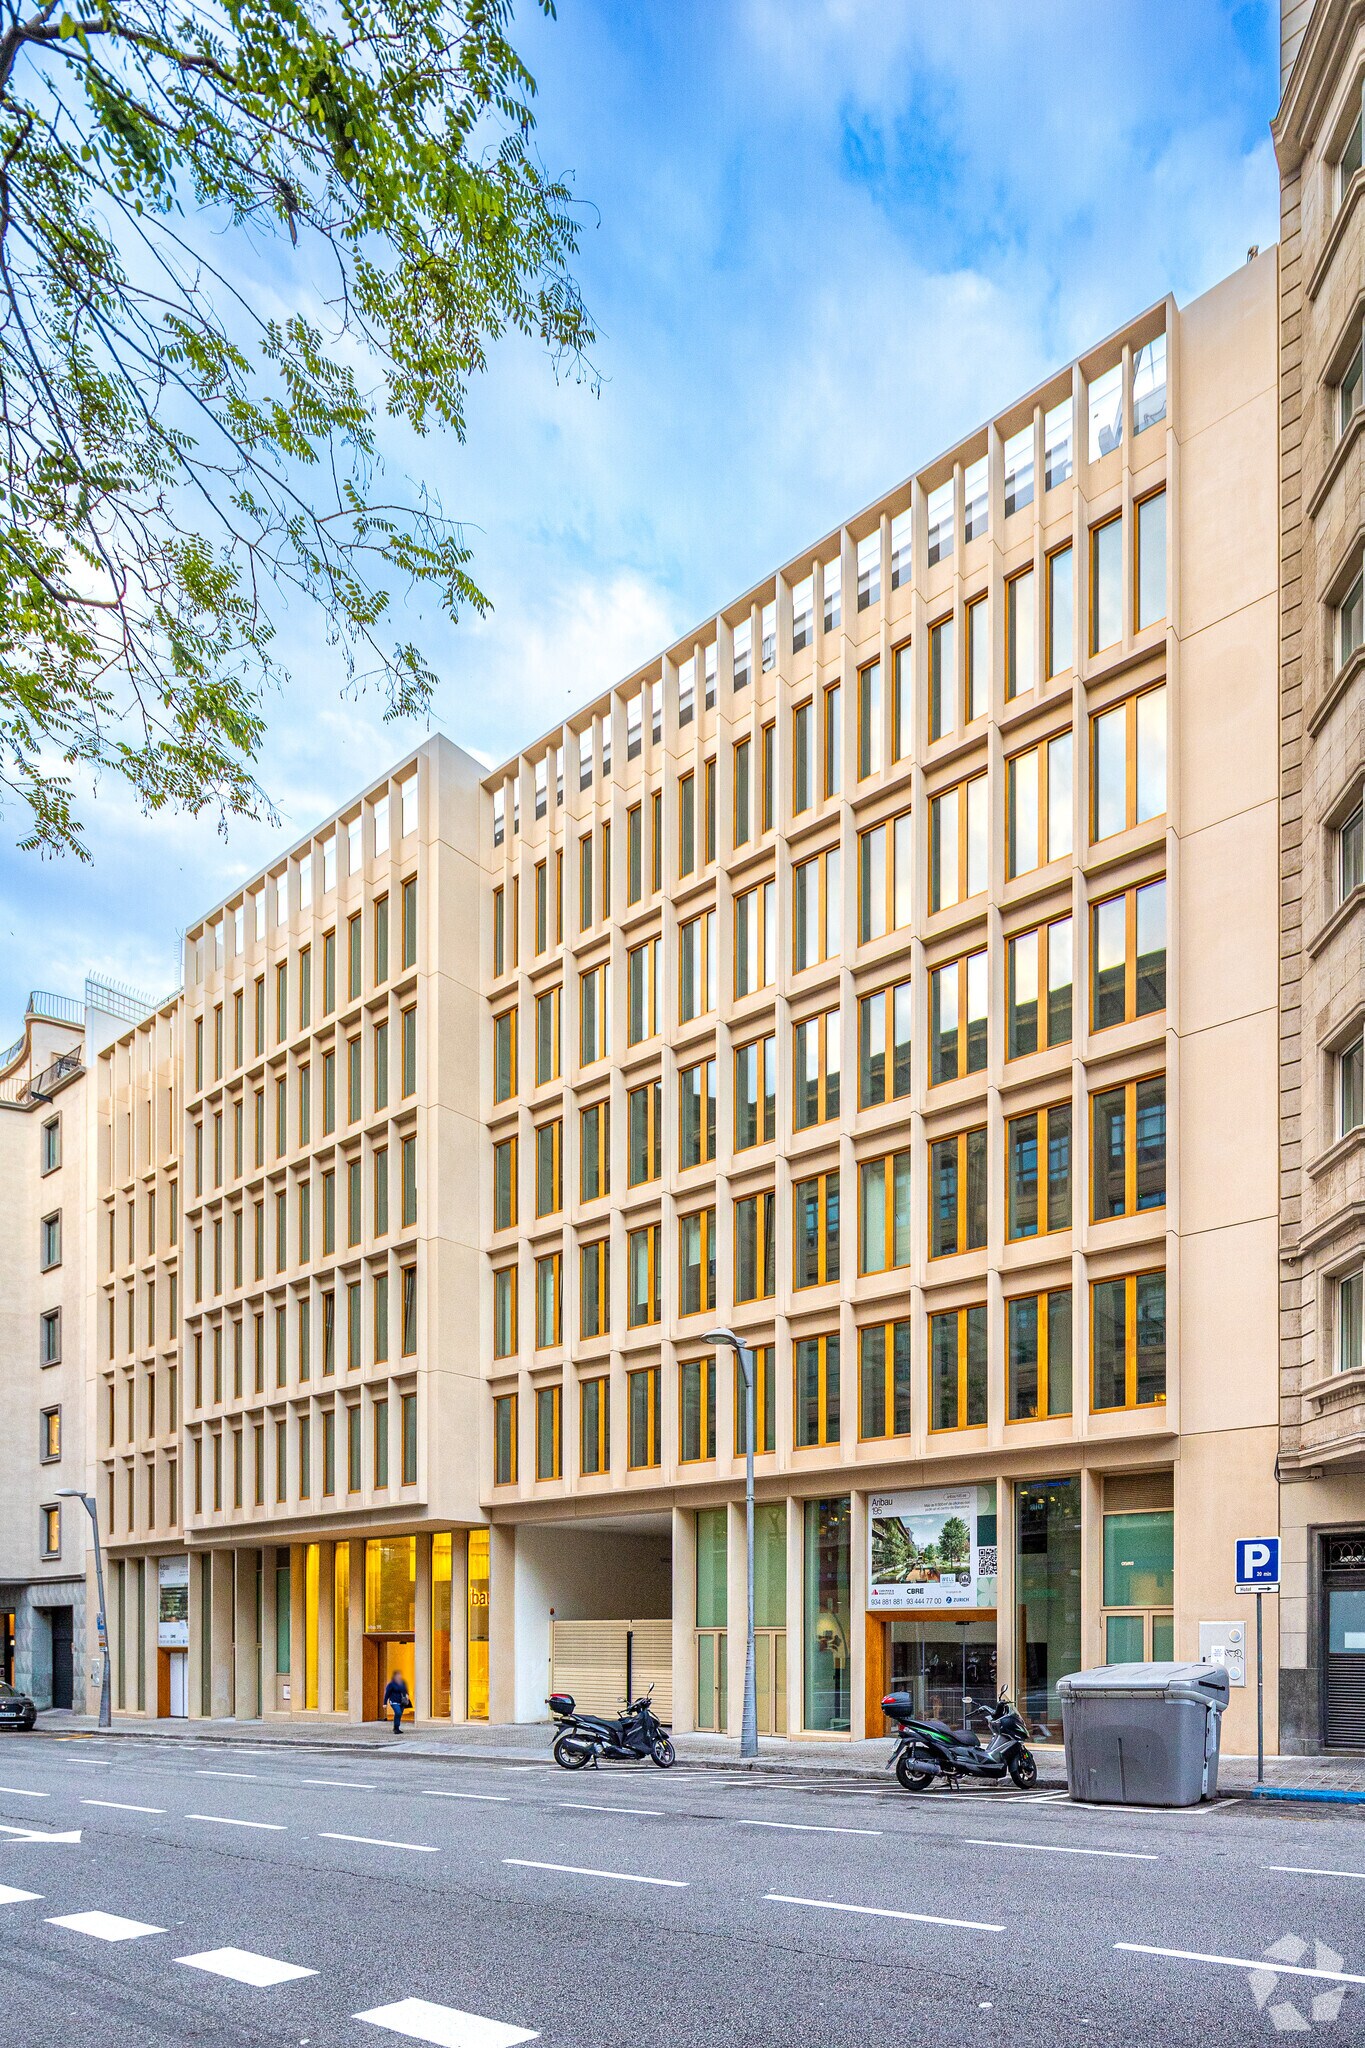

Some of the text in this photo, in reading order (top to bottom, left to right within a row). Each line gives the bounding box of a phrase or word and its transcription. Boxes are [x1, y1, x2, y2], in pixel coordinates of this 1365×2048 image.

[872, 1498, 893, 1506] Aribau
[872, 1507, 882, 1515] 195
[1244, 1544, 1270, 1578] P
